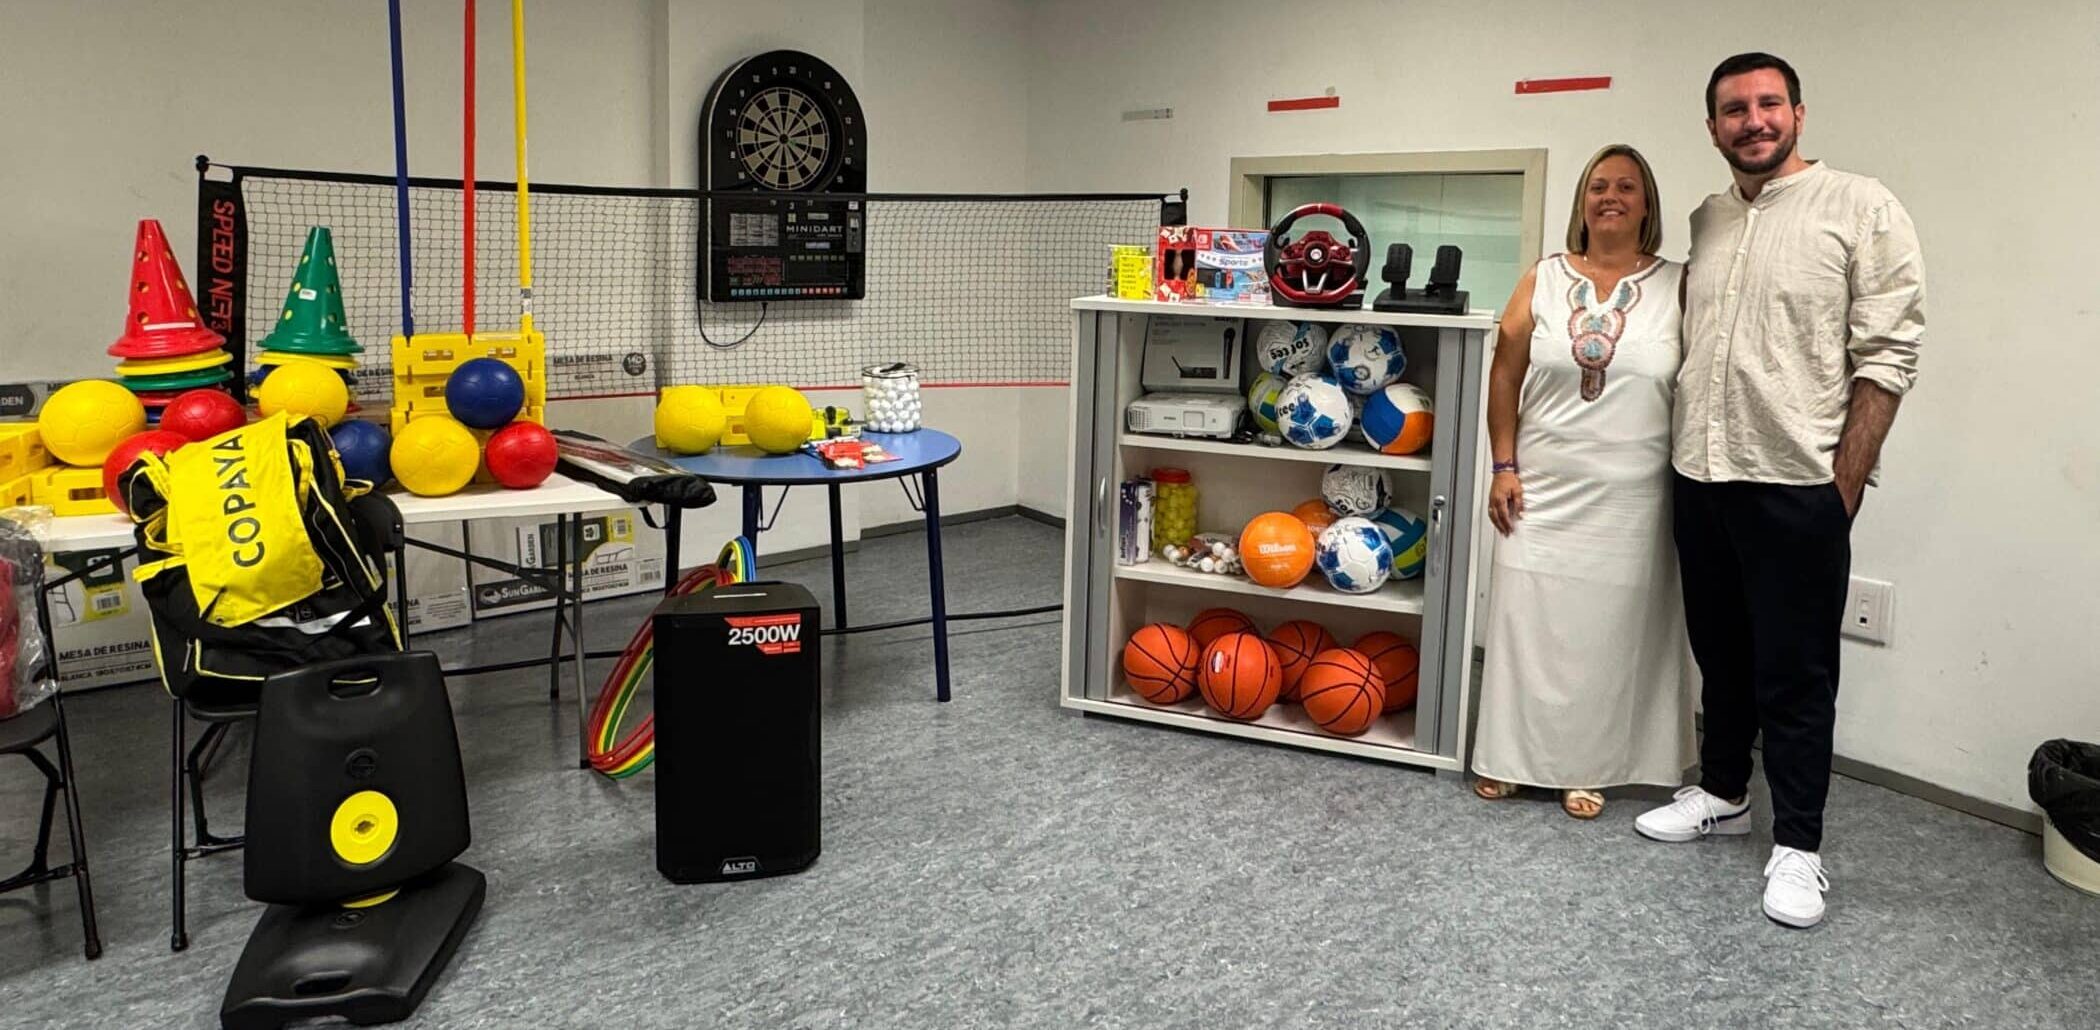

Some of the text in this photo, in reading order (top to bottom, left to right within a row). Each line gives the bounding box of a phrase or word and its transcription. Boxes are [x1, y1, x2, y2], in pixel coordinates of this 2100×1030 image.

[212, 200, 235, 274] SPEED
[786, 225, 843, 233] MINIDART
[211, 433, 266, 568] COPAYA
[728, 624, 801, 646] 2500W
[60, 640, 151, 661] MESA DE RESINA
